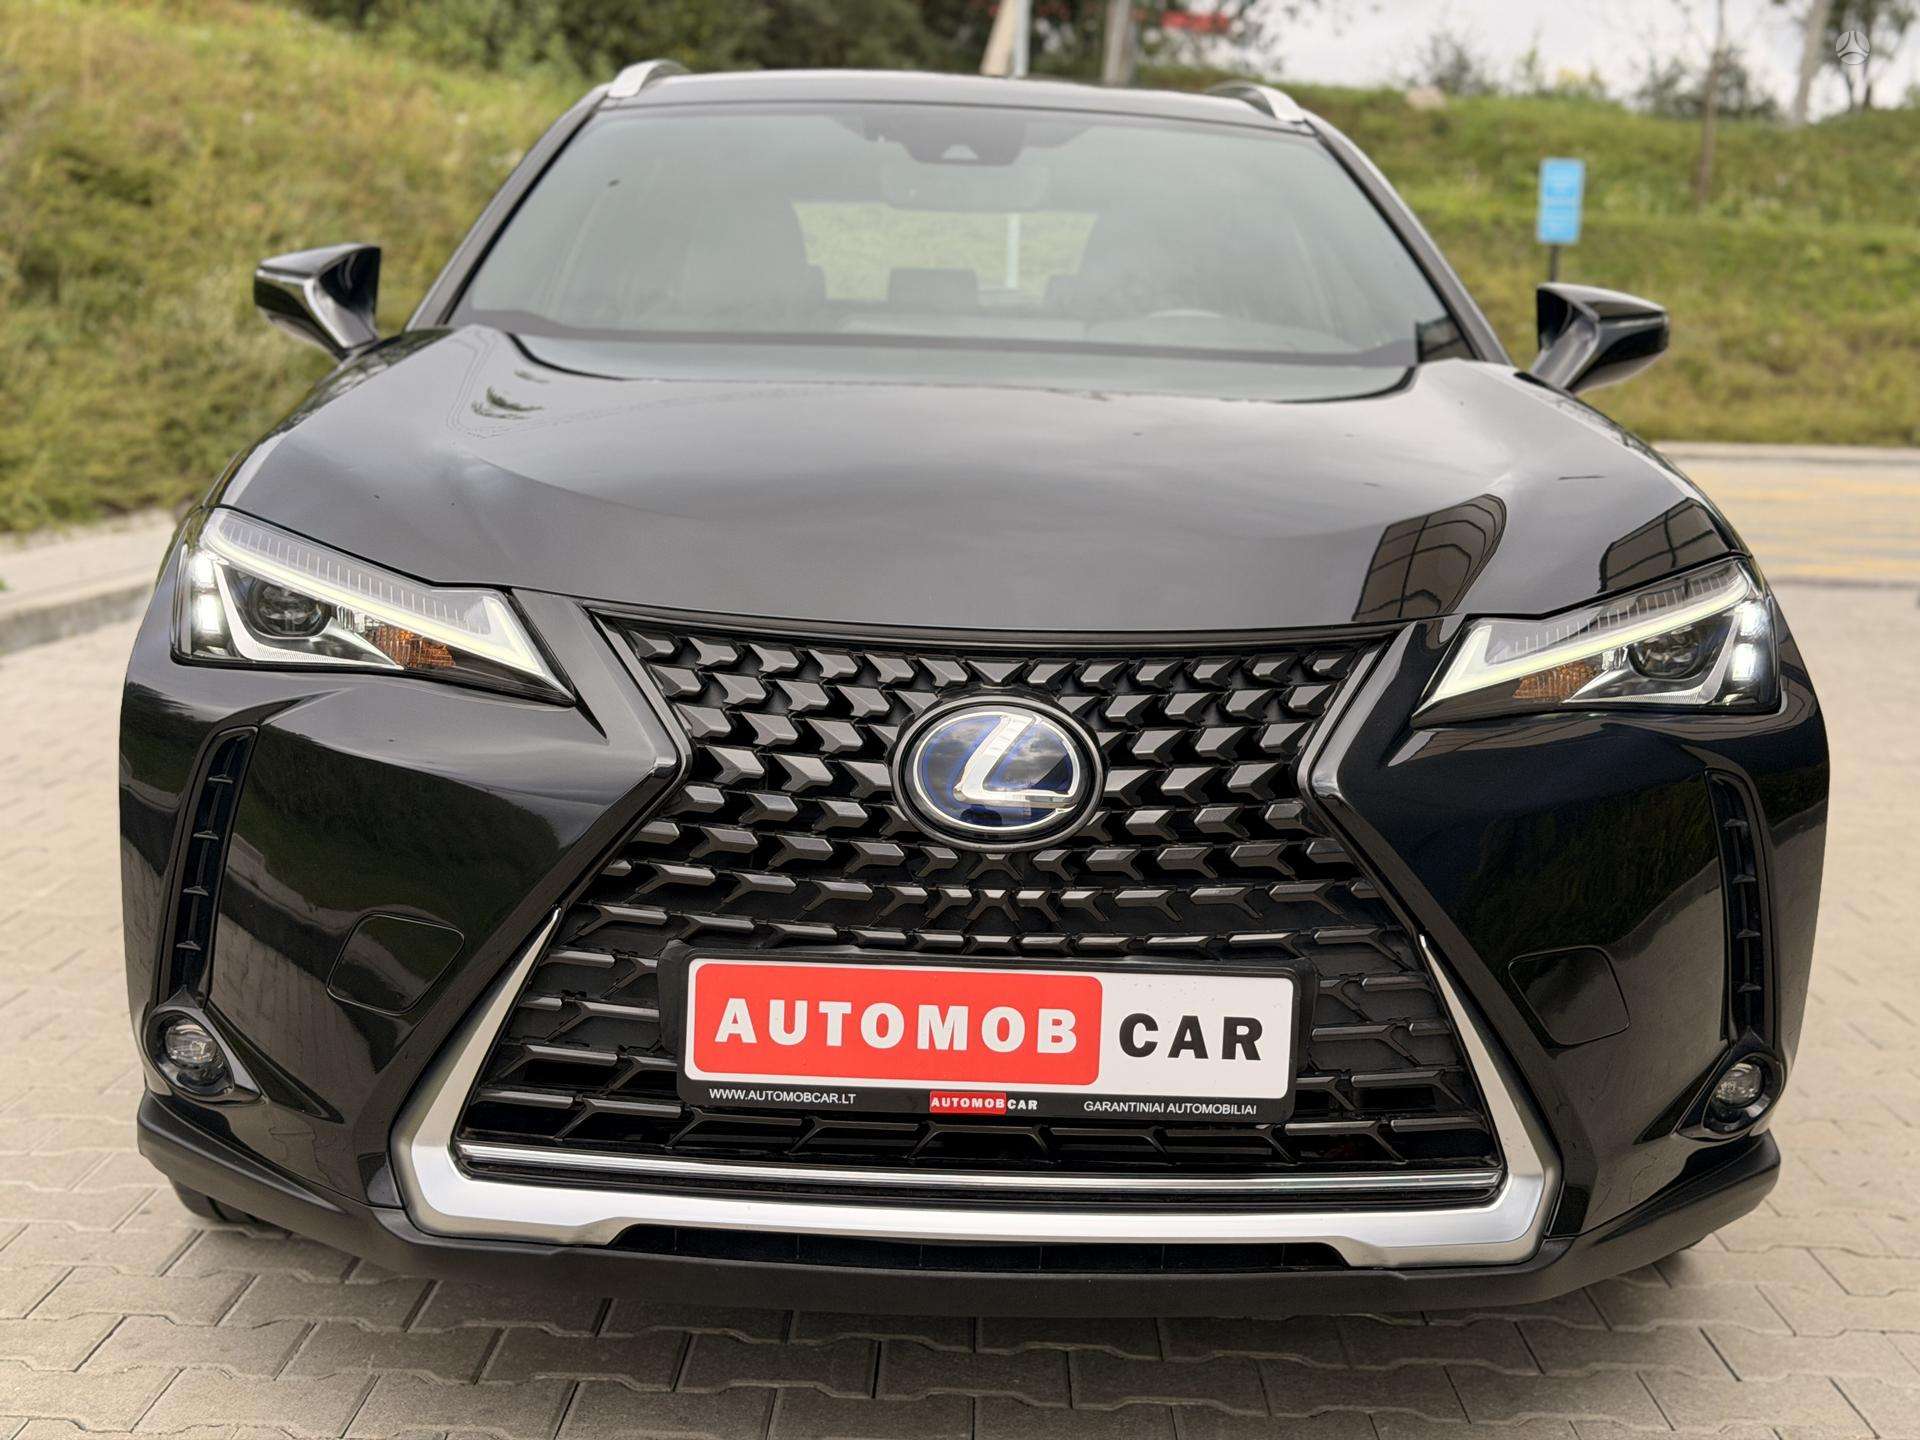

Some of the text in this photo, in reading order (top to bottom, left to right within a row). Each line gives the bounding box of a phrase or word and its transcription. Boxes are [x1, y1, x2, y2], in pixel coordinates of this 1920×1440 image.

[713, 997, 1263, 1061] AUTOMOB CAR
[709, 1088, 856, 1106] WWW.AUTOMOBCAR.LT
[1083, 1101, 1257, 1117] GARANTINIAI AUTOMOBILIAI
